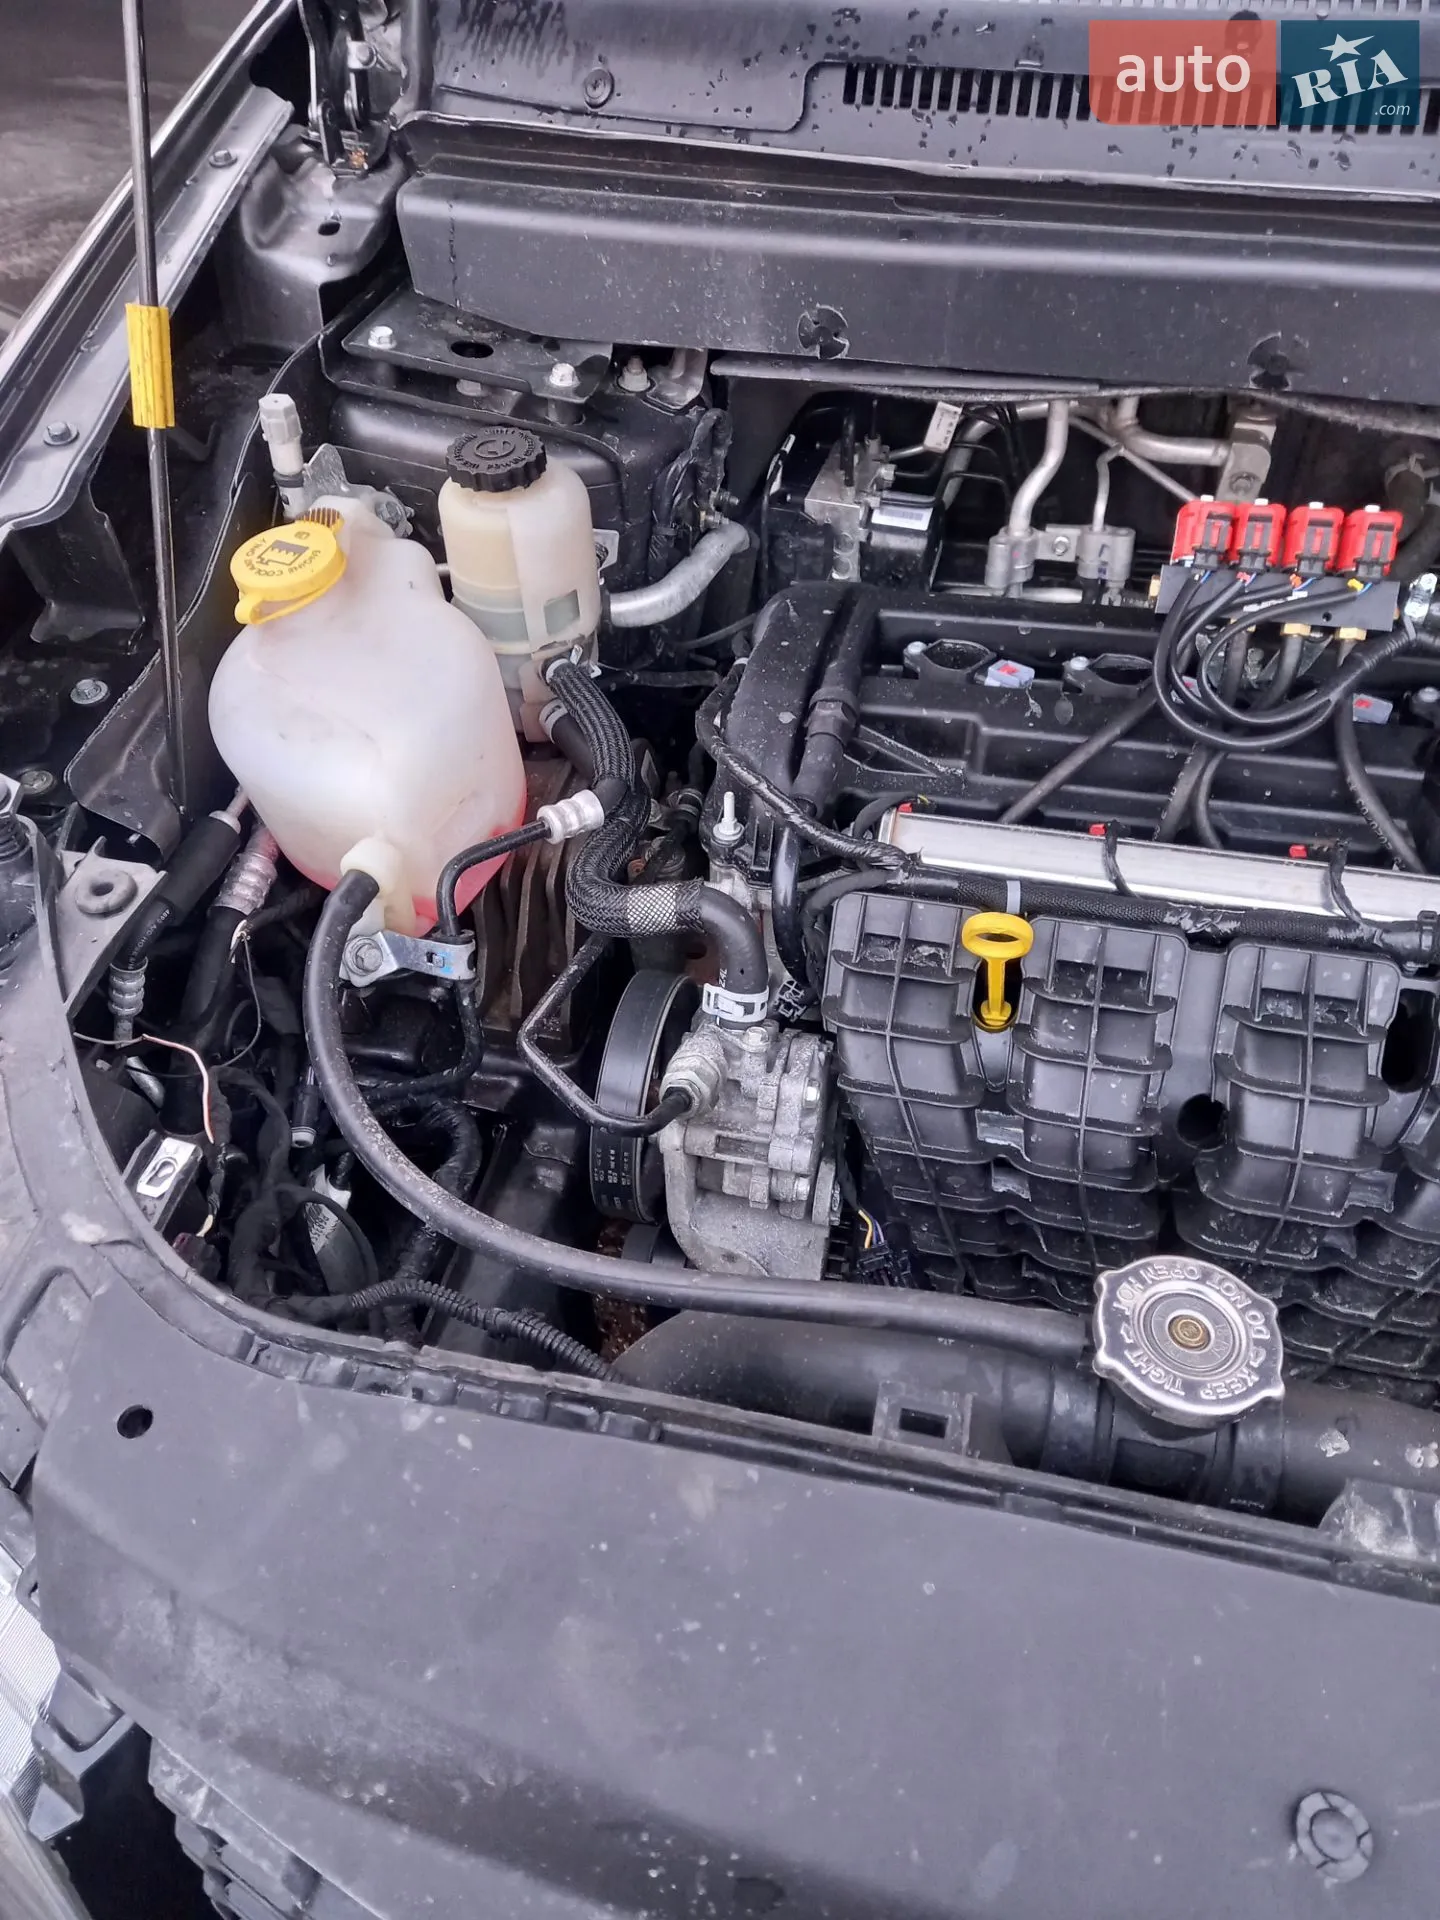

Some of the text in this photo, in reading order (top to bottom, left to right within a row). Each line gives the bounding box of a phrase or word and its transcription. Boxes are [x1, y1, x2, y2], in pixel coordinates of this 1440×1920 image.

[1112, 1263, 1270, 1339] DO NOT OPEN HOT
[1123, 1349, 1186, 1396] TIGHT
[1200, 1366, 1260, 1400] KEEP
